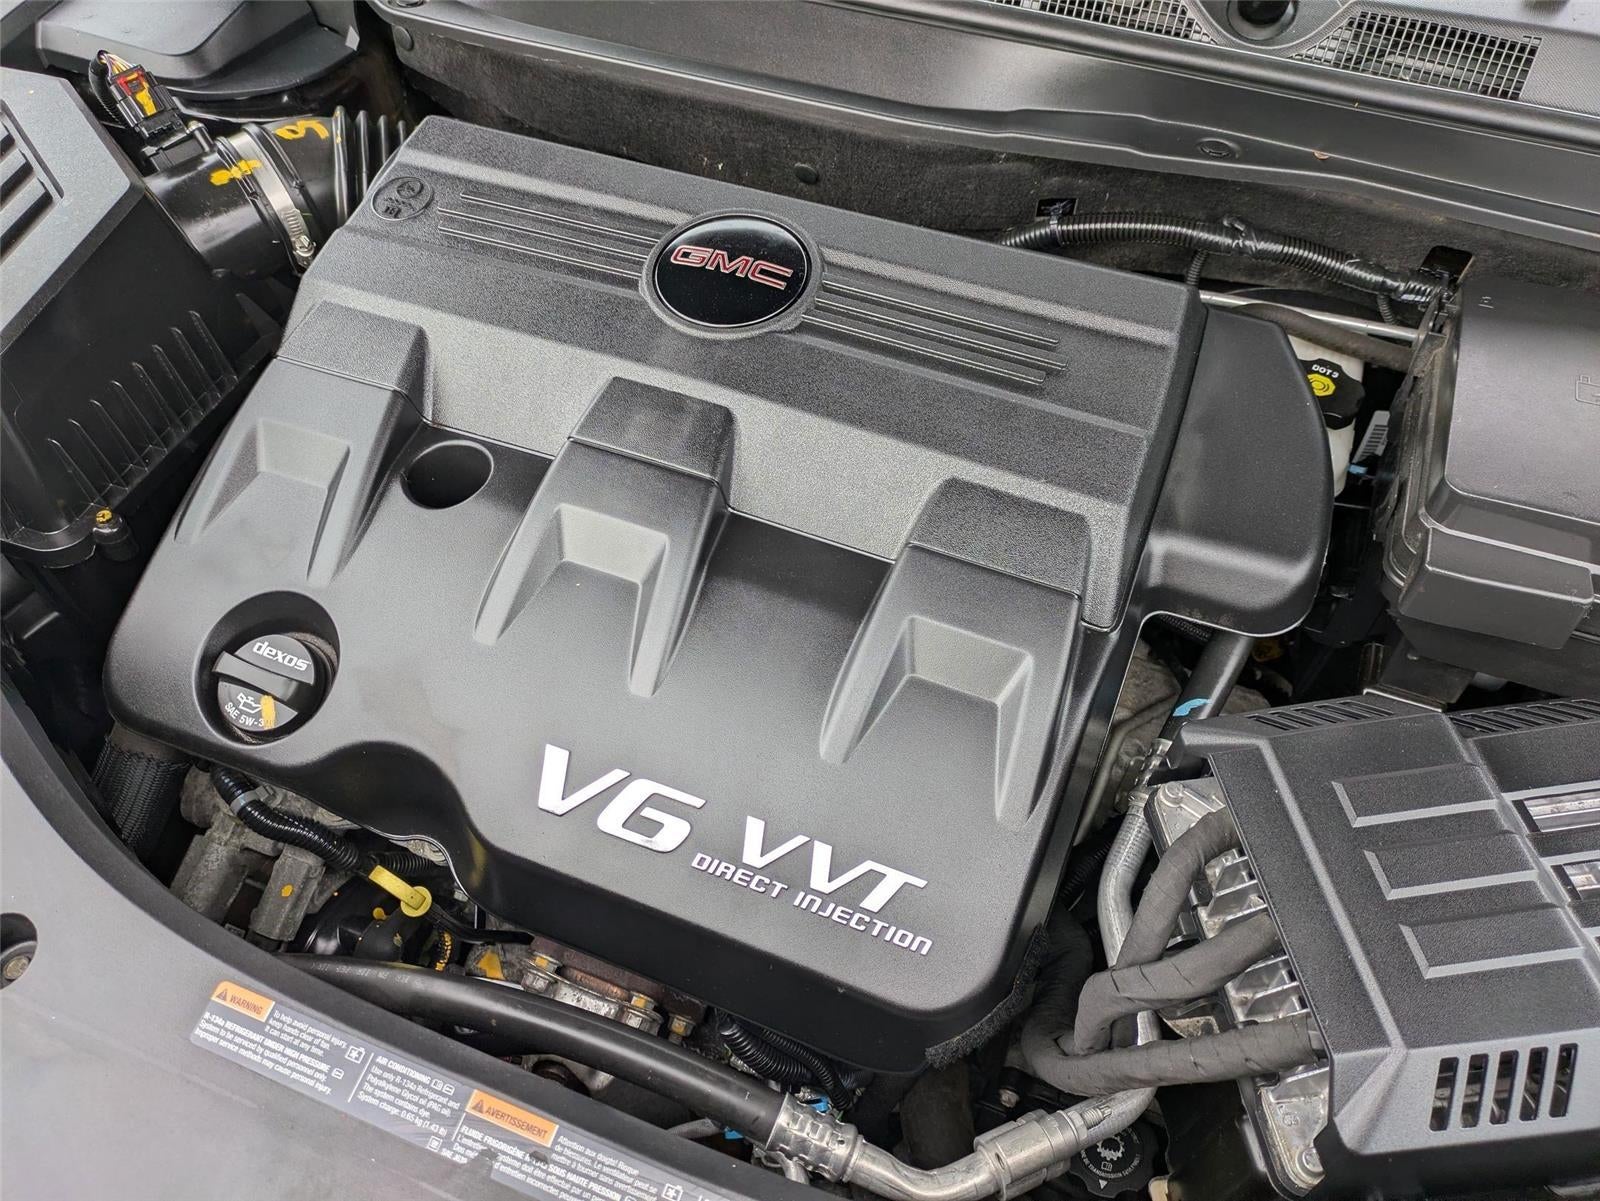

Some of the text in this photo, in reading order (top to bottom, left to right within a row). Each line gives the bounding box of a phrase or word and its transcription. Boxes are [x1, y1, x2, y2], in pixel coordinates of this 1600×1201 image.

[671, 245, 793, 290] GMC
[1313, 365, 1332, 376] DOT
[253, 641, 309, 671] dexos
[225, 702, 270, 728] SAE 5W-3
[538, 744, 928, 912] V6 VVT
[691, 853, 932, 955] DIRECT INJECTION
[230, 994, 263, 1015] WARNING
[270, 1028, 280, 1037] can
[280, 1032, 293, 1043] start
[299, 1042, 310, 1052] any
[280, 1014, 293, 1024] help
[292, 1019, 308, 1031] avoid
[307, 1026, 331, 1042] personal
[283, 1024, 300, 1036] hands
[300, 1031, 313, 1042] clear
[195, 1028, 220, 1044] Improper
[219, 1040, 239, 1052] service
[239, 1048, 263, 1063] methods
[262, 1059, 274, 1069] may
[274, 1065, 291, 1076] cause
[291, 1072, 316, 1087] personal
[200, 1020, 220, 1034] System
[226, 1032, 234, 1040] be
[233, 1035, 257, 1050] serviced
[256, 1046, 264, 1054] by
[264, 1049, 287, 1064] qualified
[287, 1059, 314, 1076] personnel
[314, 1071, 327, 1082] only.
[225, 1020, 264, 1043] REFRIGERANT
[263, 1038, 284, 1053] UNDER
[284, 1047, 300, 1059] HIGH
[299, 1053, 331, 1073] PRESSURE
[372, 1066, 460, 1109] Use only R-134a Refrigerant and
[377, 1056, 431, 1084] AIR CONDITIONING
[358, 1091, 379, 1107] System
[379, 1101, 400, 1116] charge:
[401, 1110, 415, 1121] 0.65
[414, 1117, 423, 1126] kg
[364, 1083, 374, 1093] The
[374, 1088, 395, 1103] system
[395, 1097, 418, 1112] contains
[367, 1074, 402, 1095] Polyalkylene
[401, 1089, 419, 1103] Glycol
[419, 1097, 427, 1105] oil
[427, 1101, 441, 1112] (PAG
[486, 1106, 548, 1138] AVERTISSEMENT
[454, 1143, 466, 1154] Des
[526, 1178, 559, 1196] incorrectes
[461, 1126, 483, 1140] FLUIDE
[484, 1135, 525, 1158] FRIGORIGÈNE
[548, 1164, 567, 1177] SOUS
[566, 1172, 589, 1186] HAUTE
[589, 1182, 622, 1201] PRESSION
[551, 1154, 571, 1166] mettre
[577, 1165, 598, 1178] tourner
[599, 1174, 614, 1185] sans
[555, 1144, 658, 1194] de blessures. Le ventilateur peut se
[558, 1136, 640, 1176] Attention aux doigts! Risque
[521, 1164, 533, 1173] doit
[533, 1168, 546, 1179] être
[570, 1186, 582, 1196] par
[582, 1191, 591, 1199] un
